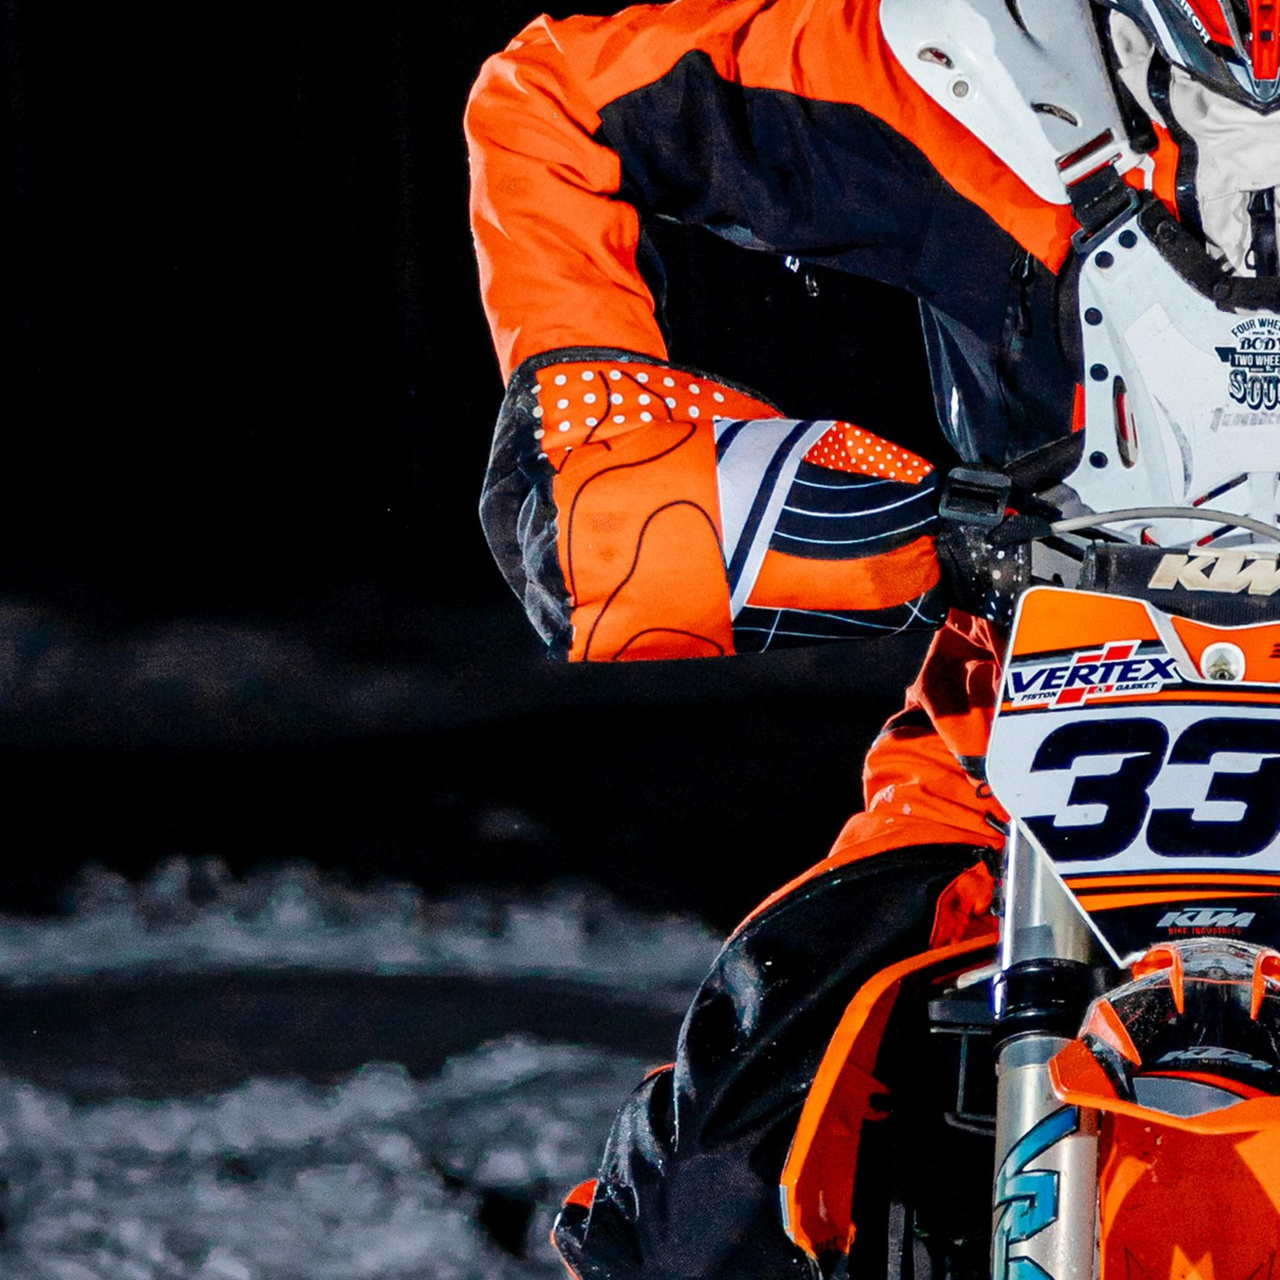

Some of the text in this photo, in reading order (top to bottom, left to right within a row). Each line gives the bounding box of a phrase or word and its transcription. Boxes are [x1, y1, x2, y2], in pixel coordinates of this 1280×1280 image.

[1231, 319, 1256, 338] FOUR
[1234, 354, 1254, 366] TWO
[1012, 658, 1178, 694] VERTEX
[1021, 691, 1057, 701] PISTON
[1116, 682, 1157, 691] GASKET
[1156, 908, 1256, 927] KTM
[1156, 1046, 1273, 1071] KTM
